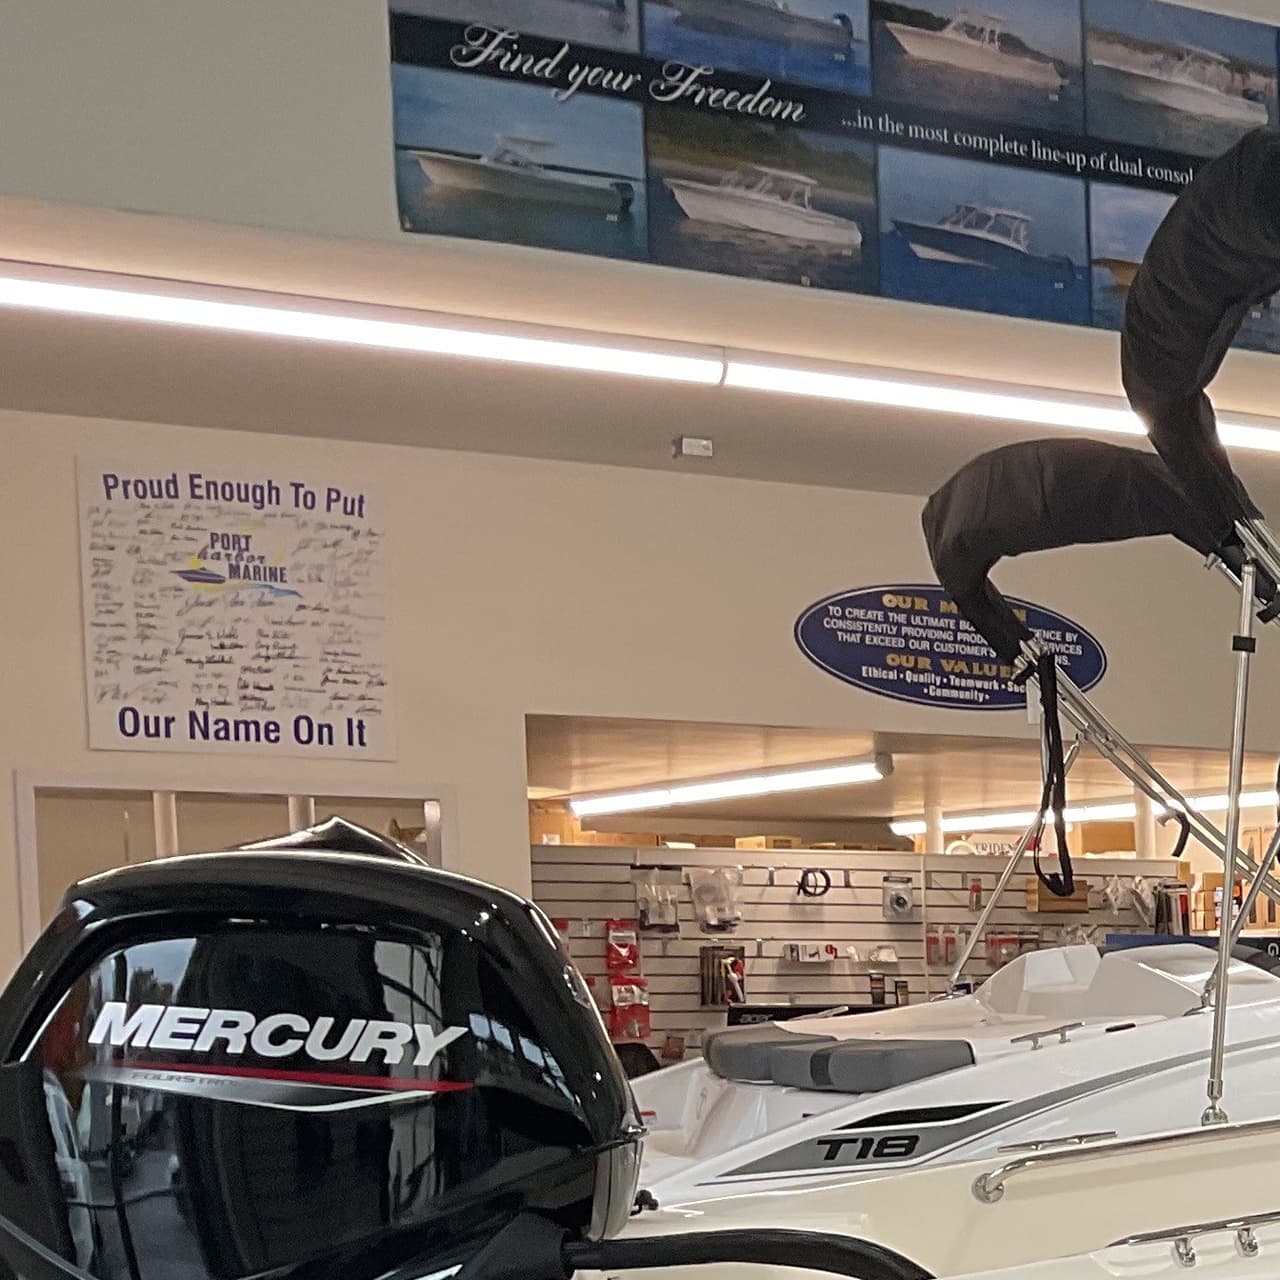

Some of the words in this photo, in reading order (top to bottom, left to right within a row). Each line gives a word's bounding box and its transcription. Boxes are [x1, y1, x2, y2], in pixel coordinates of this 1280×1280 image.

[450, 24, 569, 79] Find
[553, 65, 641, 102] your
[649, 60, 806, 123] Freedom
[878, 113, 904, 137] the
[908, 124, 949, 145] most
[953, 131, 1028, 158] complete
[1031, 140, 1086, 171] line-up
[1090, 152, 1107, 171] of
[1109, 156, 1143, 177] dual
[1147, 166, 1194, 185] consol
[102, 473, 179, 500] Proud
[189, 473, 281, 509] Enough
[290, 482, 316, 510] To
[326, 487, 365, 519] Put
[197, 544, 265, 564] harbor
[210, 532, 252, 552] PORT
[228, 563, 288, 584] MARINE
[882, 593, 930, 611] OUR
[823, 618, 898, 635] CONSISTENTLY
[901, 626, 953, 640] PROVIDING
[828, 605, 842, 617] TO
[845, 607, 884, 621] CREATE
[888, 612, 908, 624] THE
[911, 614, 956, 629] ULTIMATE
[1066, 632, 1079, 643] BY
[837, 631, 862, 644] THAT
[865, 634, 905, 648] EXCEED
[909, 640, 930, 651] OUR
[933, 641, 997, 658] CUSTOMER'S
[886, 653, 933, 671] OUR
[861, 665, 898, 680] Ethical
[905, 670, 941, 686] Quality
[948, 674, 999, 690] Teamwork
[929, 685, 984, 702] Community
[118, 706, 176, 739] Our
[188, 710, 281, 744] Name
[294, 714, 334, 746] On
[347, 717, 367, 747] It
[88, 1002, 470, 1068] MERCURY
[816, 1135, 921, 1161] T18
